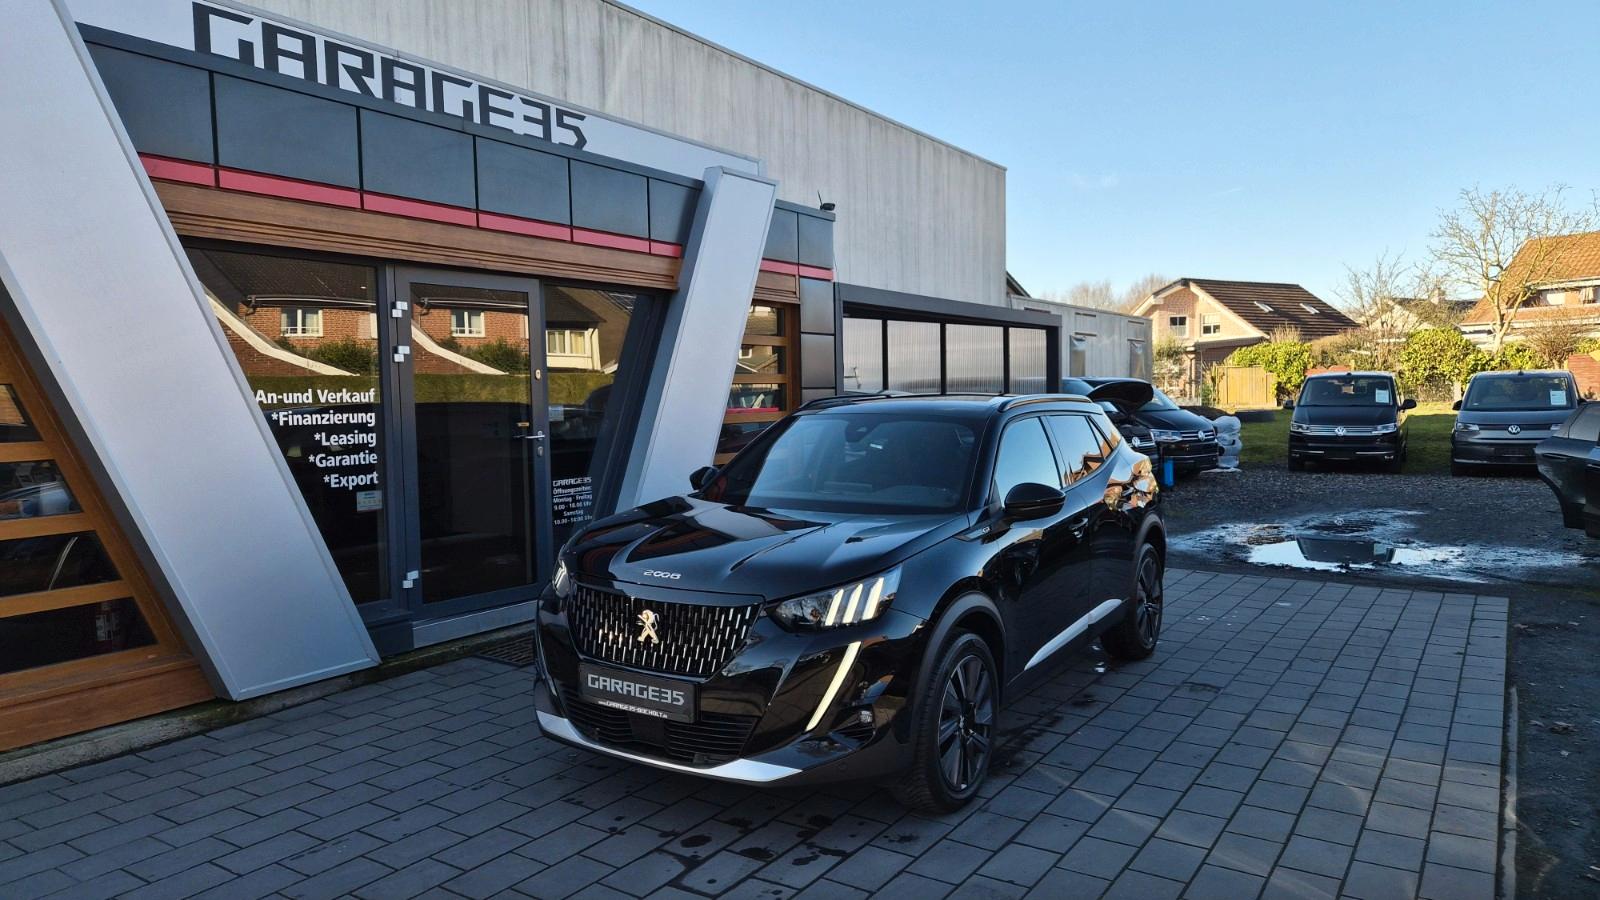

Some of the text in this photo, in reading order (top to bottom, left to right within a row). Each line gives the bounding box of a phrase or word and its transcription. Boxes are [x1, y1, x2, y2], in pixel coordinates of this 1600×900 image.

[193, 1, 588, 151] GARAGE35
[255, 388, 376, 404] An-und Verkauf
[643, 569, 682, 580] 2008
[587, 673, 685, 706] GARAGE35
